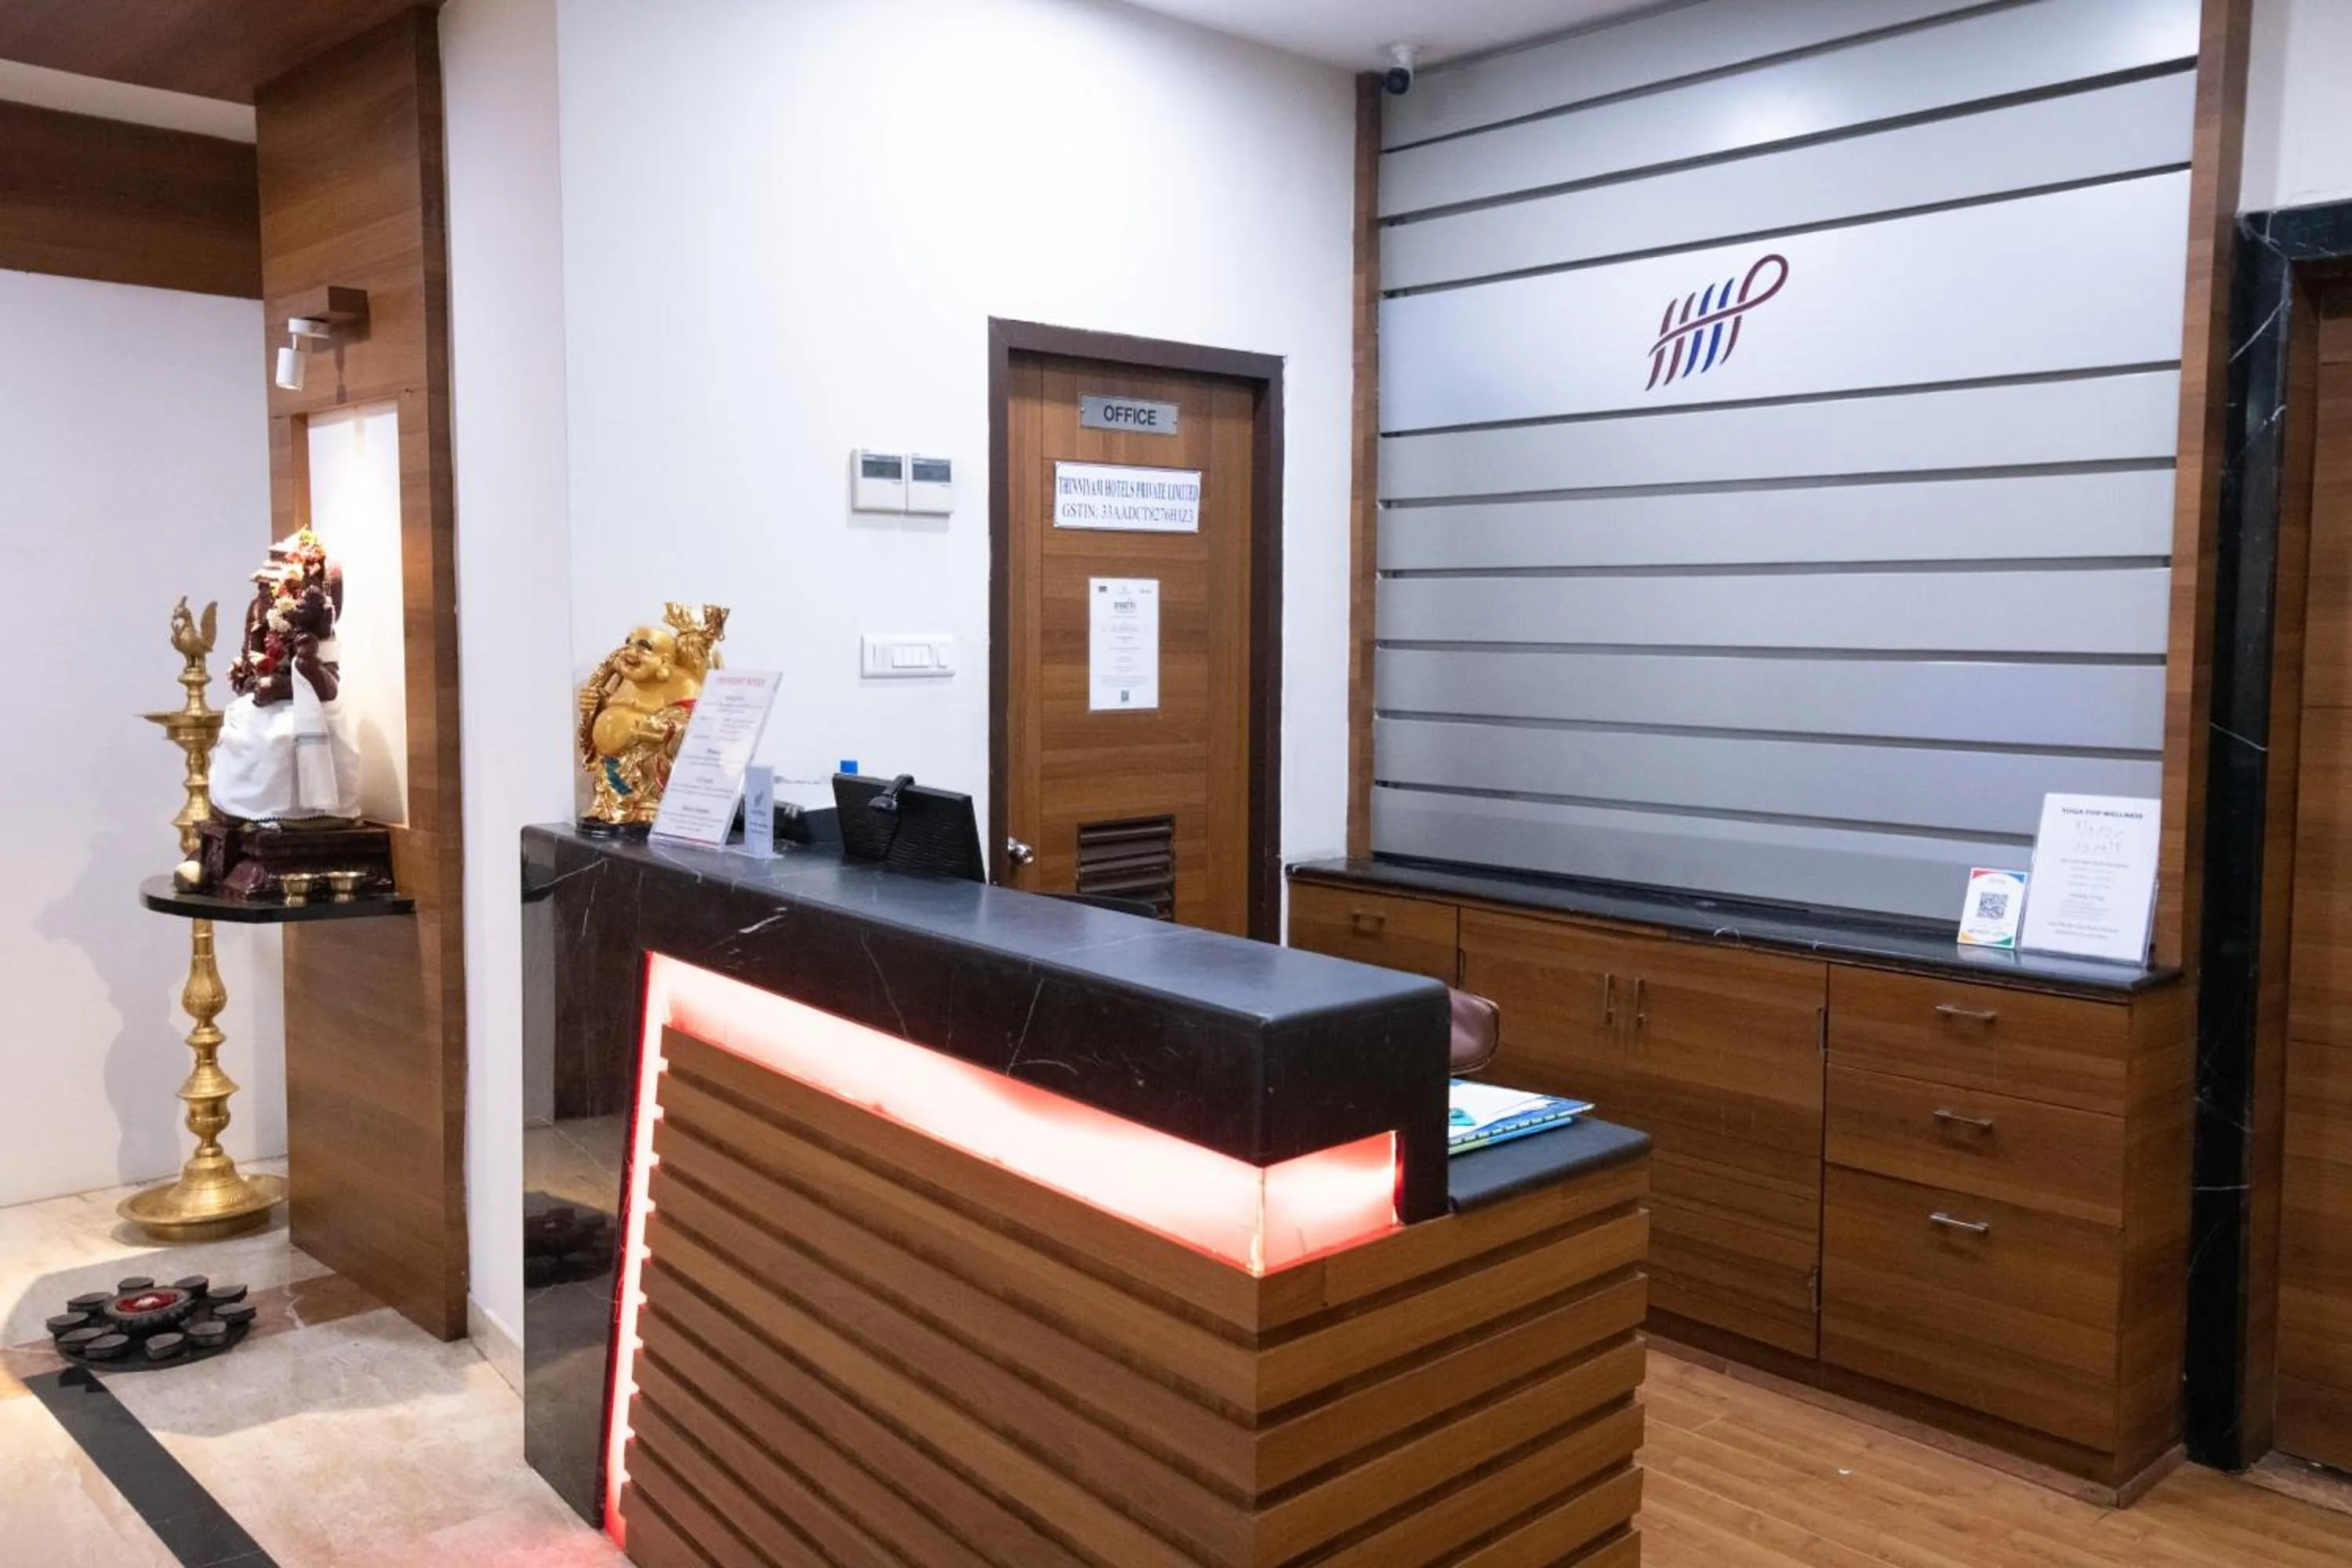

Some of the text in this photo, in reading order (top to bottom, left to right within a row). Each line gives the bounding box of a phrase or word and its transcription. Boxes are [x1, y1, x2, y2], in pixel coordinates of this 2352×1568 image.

[1103, 405, 1157, 426] OFFICE
[1105, 479, 1134, 498] HOTELS
[1137, 481, 1167, 500] PRIVATE
[1167, 483, 1198, 503] LIMITED
